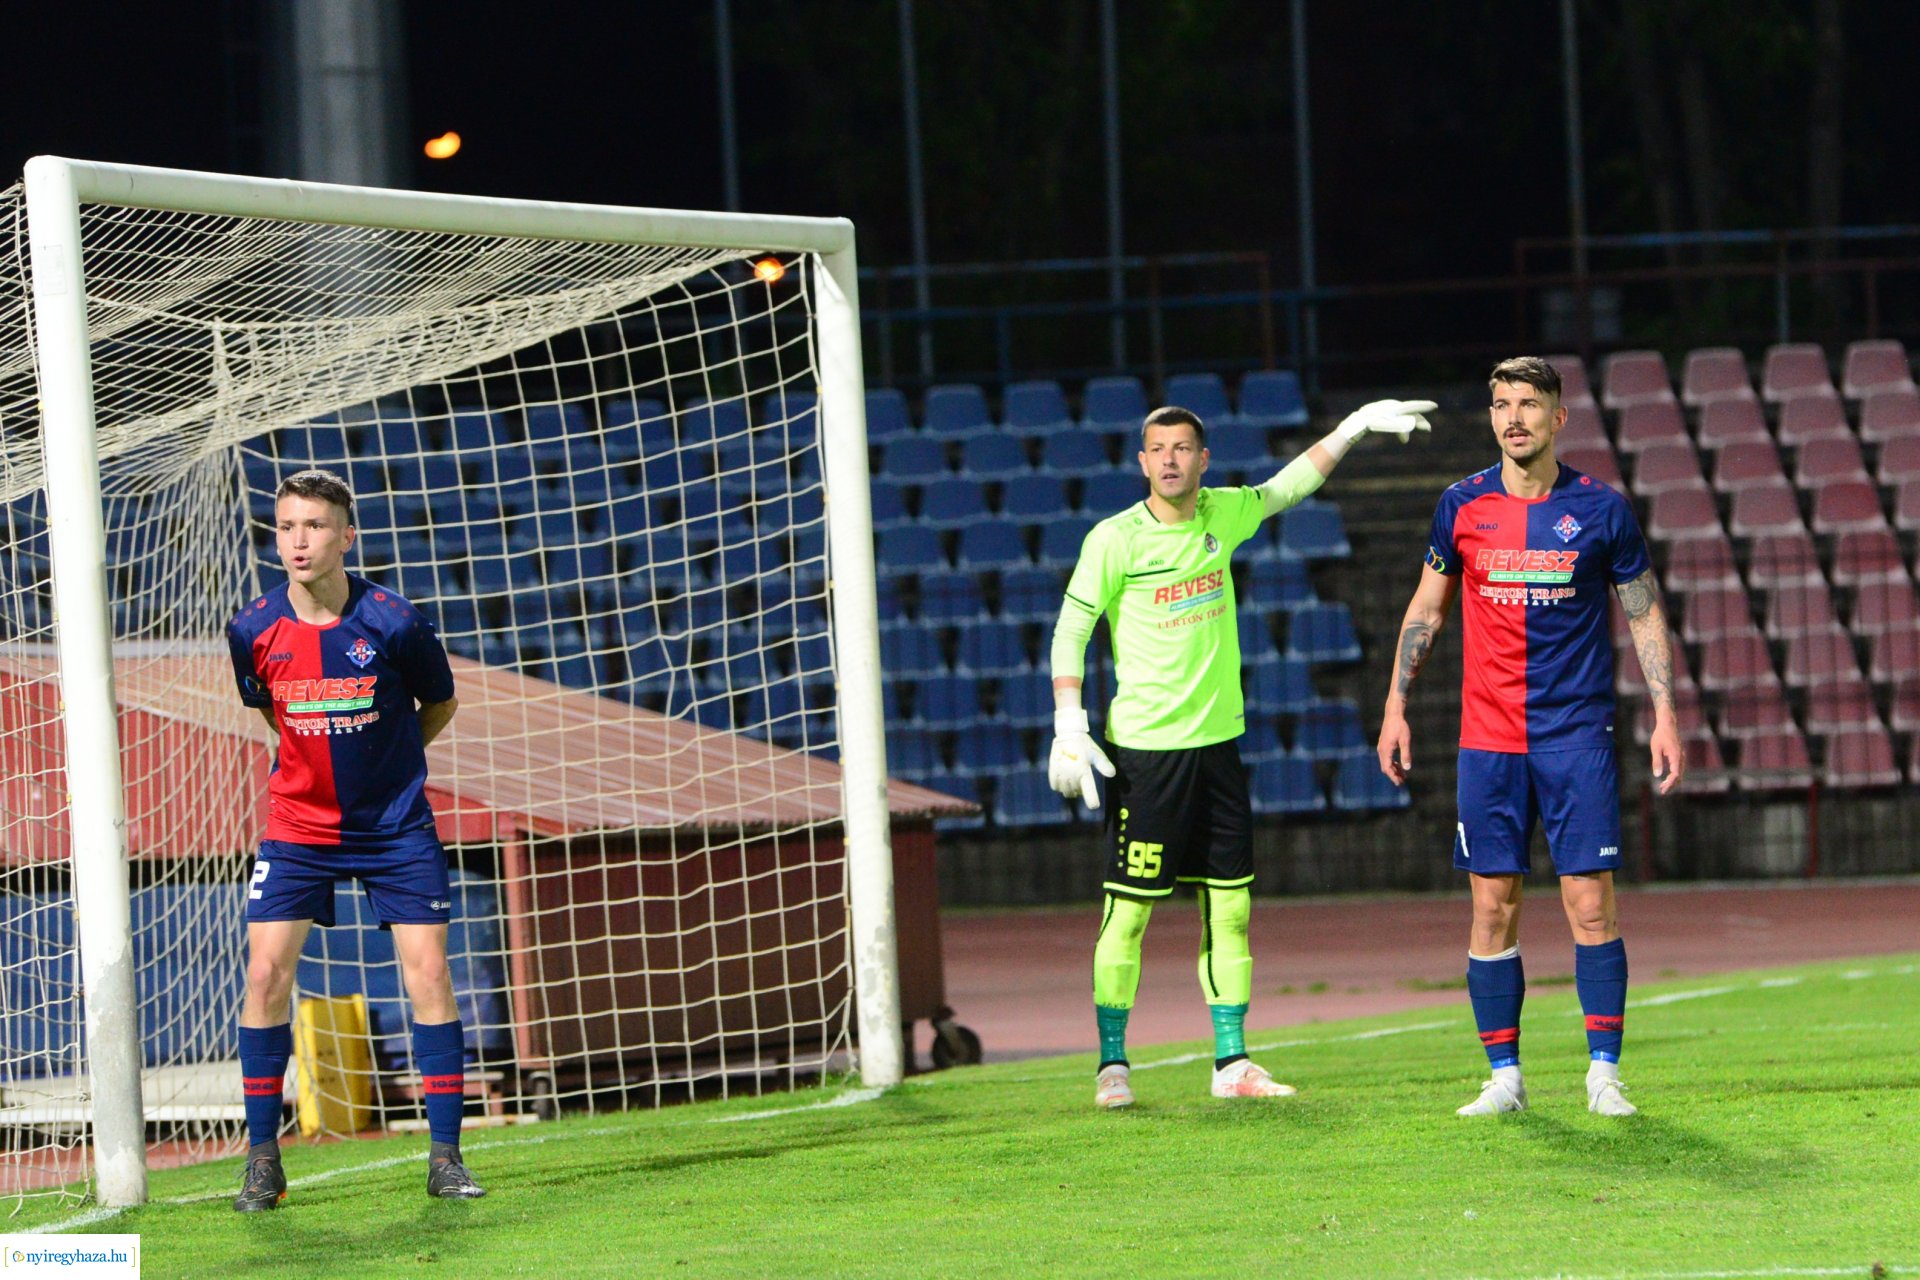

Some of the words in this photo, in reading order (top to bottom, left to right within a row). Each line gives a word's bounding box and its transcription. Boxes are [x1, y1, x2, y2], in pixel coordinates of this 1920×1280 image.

[1476, 549, 1579, 571] REVESZ
[1154, 569, 1223, 605] REVESZ
[269, 652, 294, 661] JAKO
[273, 676, 377, 702] REVESZ
[1127, 841, 1163, 879] 95
[1599, 847, 1618, 856] JAKO
[249, 861, 270, 899] 2
